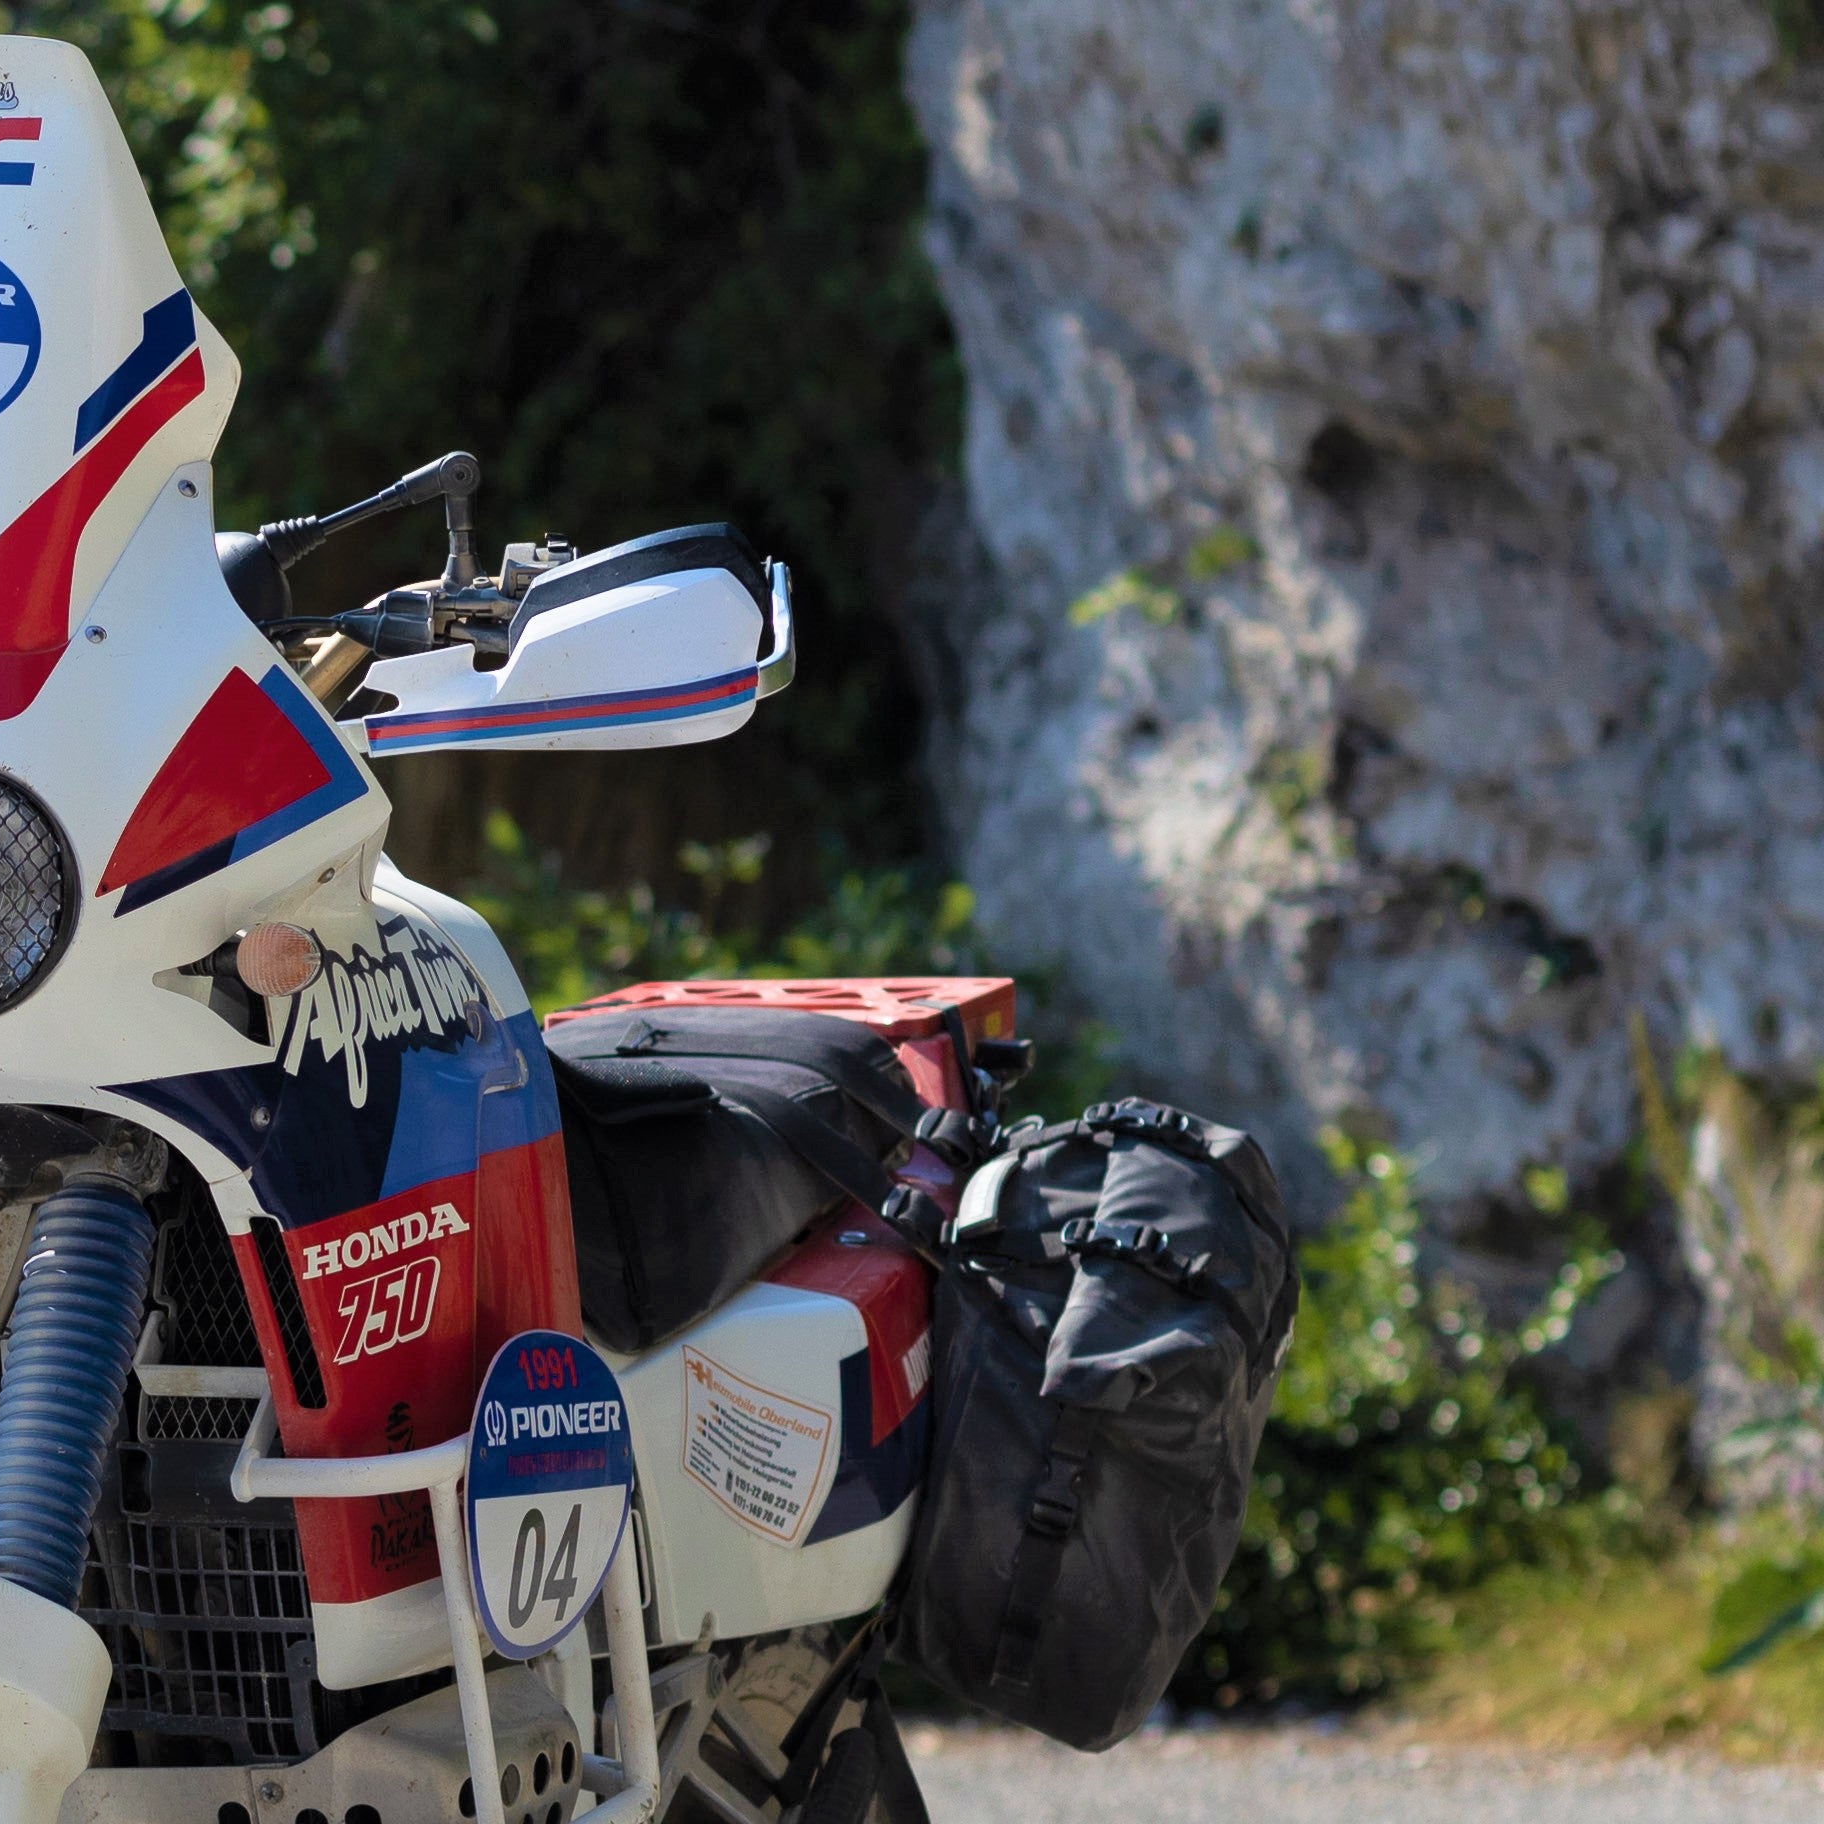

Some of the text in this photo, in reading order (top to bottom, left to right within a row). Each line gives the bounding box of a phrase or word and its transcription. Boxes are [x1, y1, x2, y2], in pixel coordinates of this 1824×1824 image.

[283, 952, 422, 1109] Africa
[302, 1202, 470, 1280] HONDA
[333, 1256, 440, 1366] 750
[517, 1347, 578, 1391] 1991
[511, 1400, 621, 1440] PIONEER
[759, 1406, 823, 1441] Oberland
[508, 1503, 583, 1630] 04
